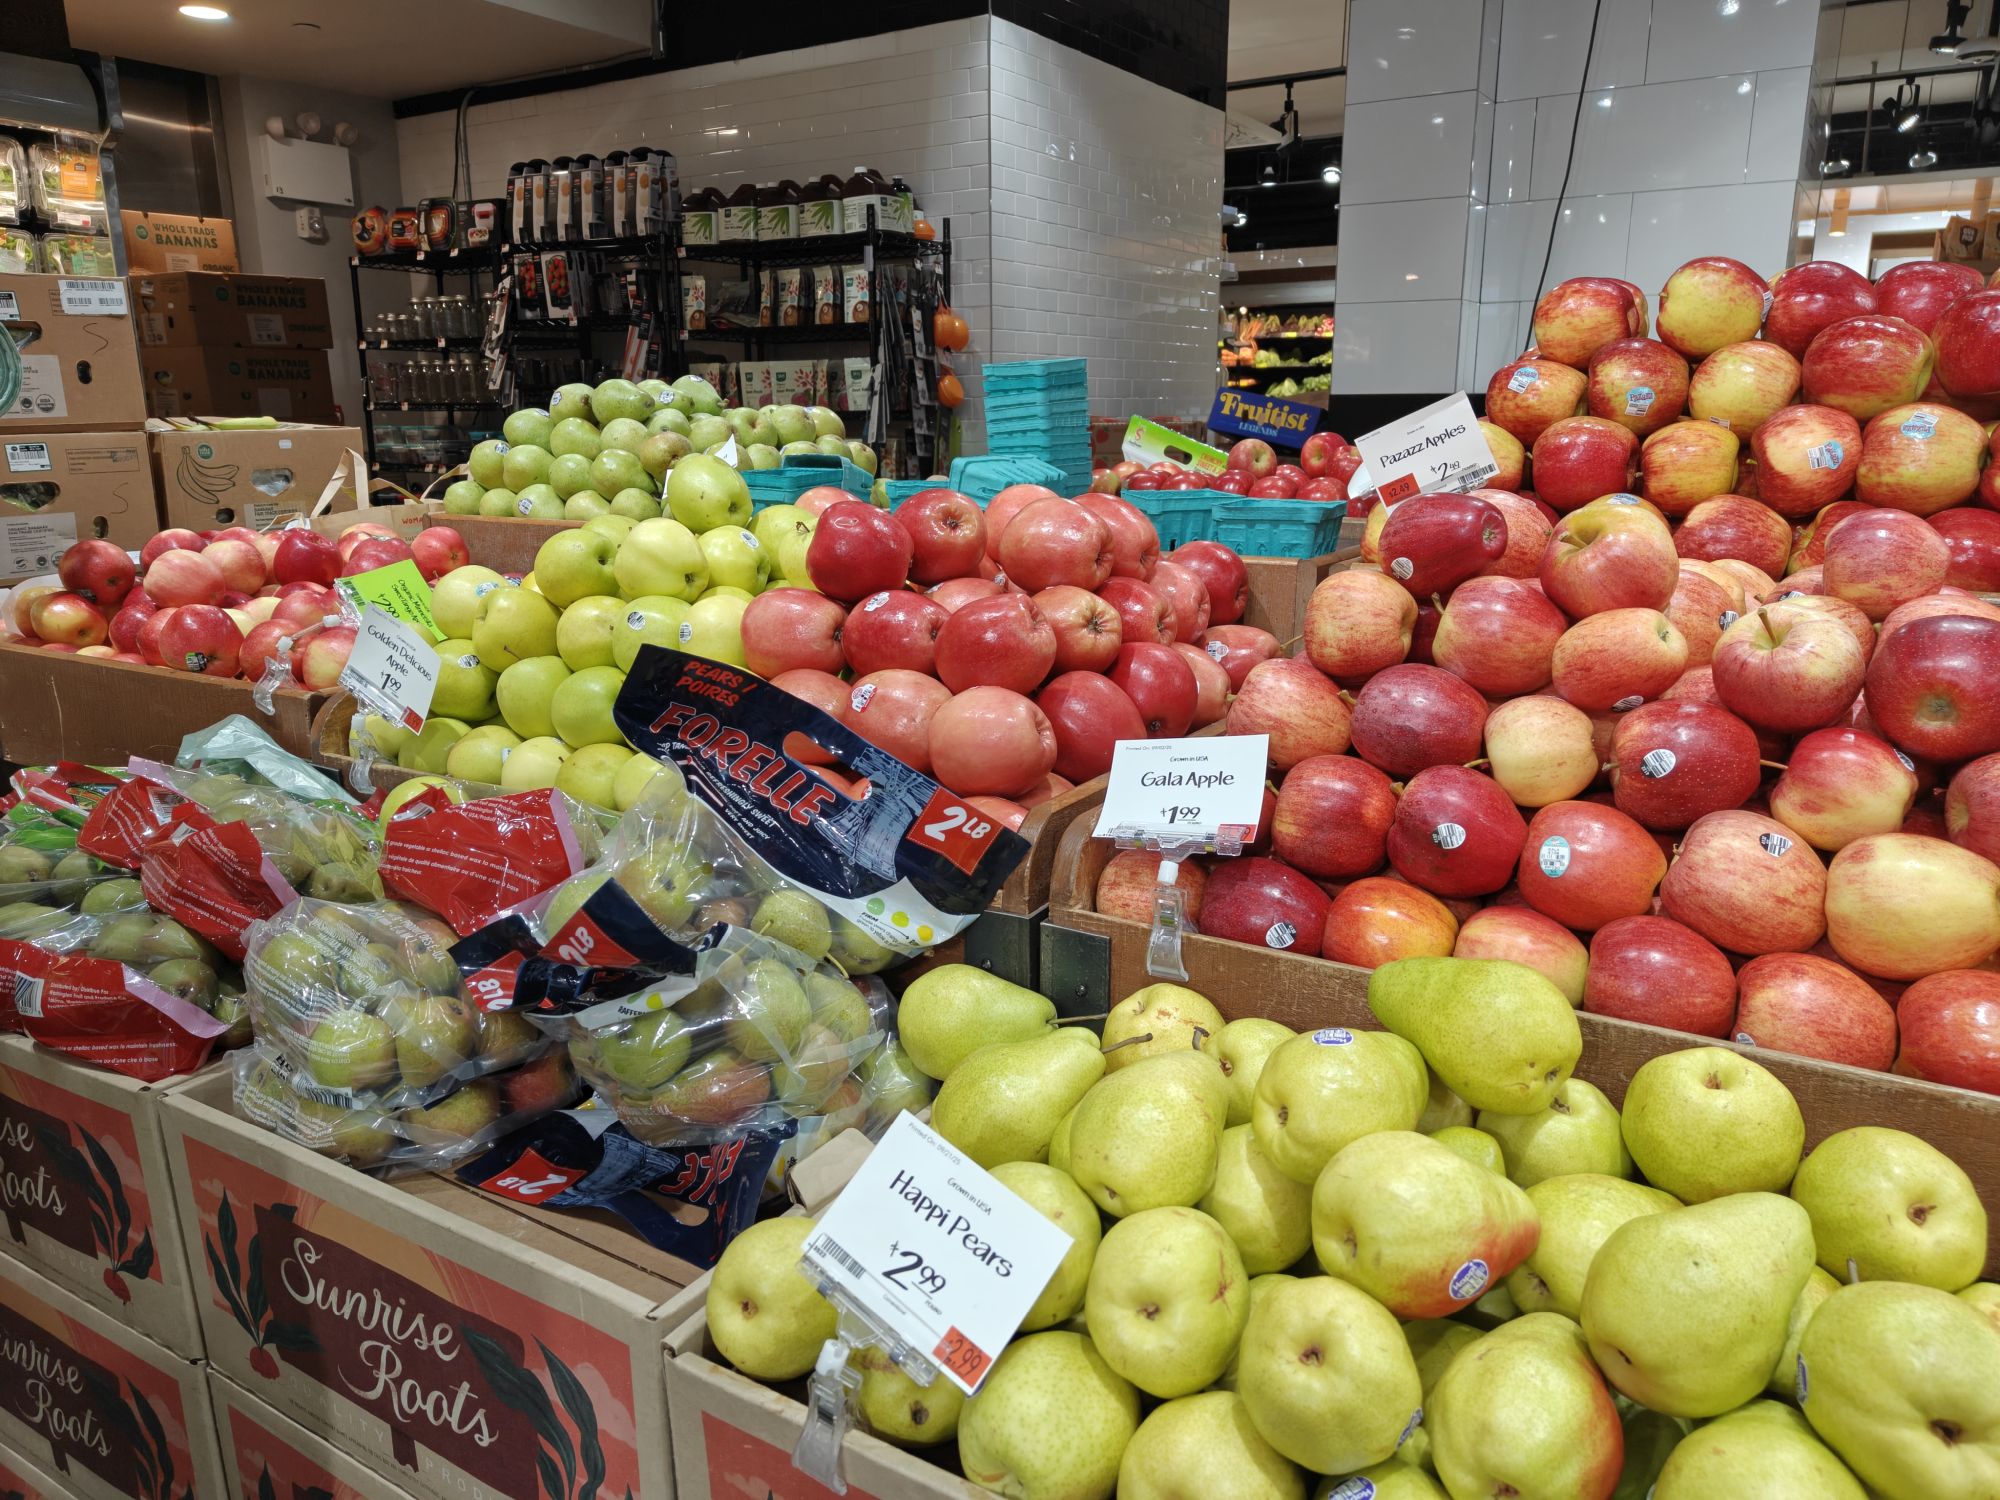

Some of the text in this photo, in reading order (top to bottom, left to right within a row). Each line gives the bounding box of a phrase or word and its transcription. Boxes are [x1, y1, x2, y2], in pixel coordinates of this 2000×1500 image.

[152, 223, 216, 236] WHOLE TRADE
[155, 234, 218, 249] BANANAS
[202, 263, 234, 273] ORGANIC
[236, 296, 307, 309] BANANAS
[248, 369, 311, 381] BANANAS
[1220, 392, 1309, 431] Fruitist
[1238, 422, 1279, 437] LEGENDS
[1379, 442, 1425, 468] Pazazz
[1424, 424, 1466, 449] Apples
[368, 624, 399, 651] Golden
[400, 646, 432, 682] Delicious
[386, 654, 408, 677] Apple
[683, 660, 744, 689] PEARS
[675, 675, 740, 707] POIRES
[649, 701, 837, 828] FORELLE
[1141, 771, 1235, 788] Gala Apple
[706, 771, 777, 828] REFRESHINGLY SWEET
[724, 808, 755, 839] VERY SWEET
[450, 851, 468, 861] based
[469, 871, 487, 881] d'une
[488, 877, 500, 885] cire
[506, 883, 519, 893] base
[861, 911, 879, 922] FIRM
[907, 1121, 929, 1142] Printed
[947, 1177, 970, 1199] Grown
[976, 1199, 993, 1216] USA
[889, 1169, 1014, 1278] Happi Pears
[280, 1237, 461, 1362] Sunrise
[337, 1339, 500, 1448] Roots
[16, 1379, 112, 1457] Roots
